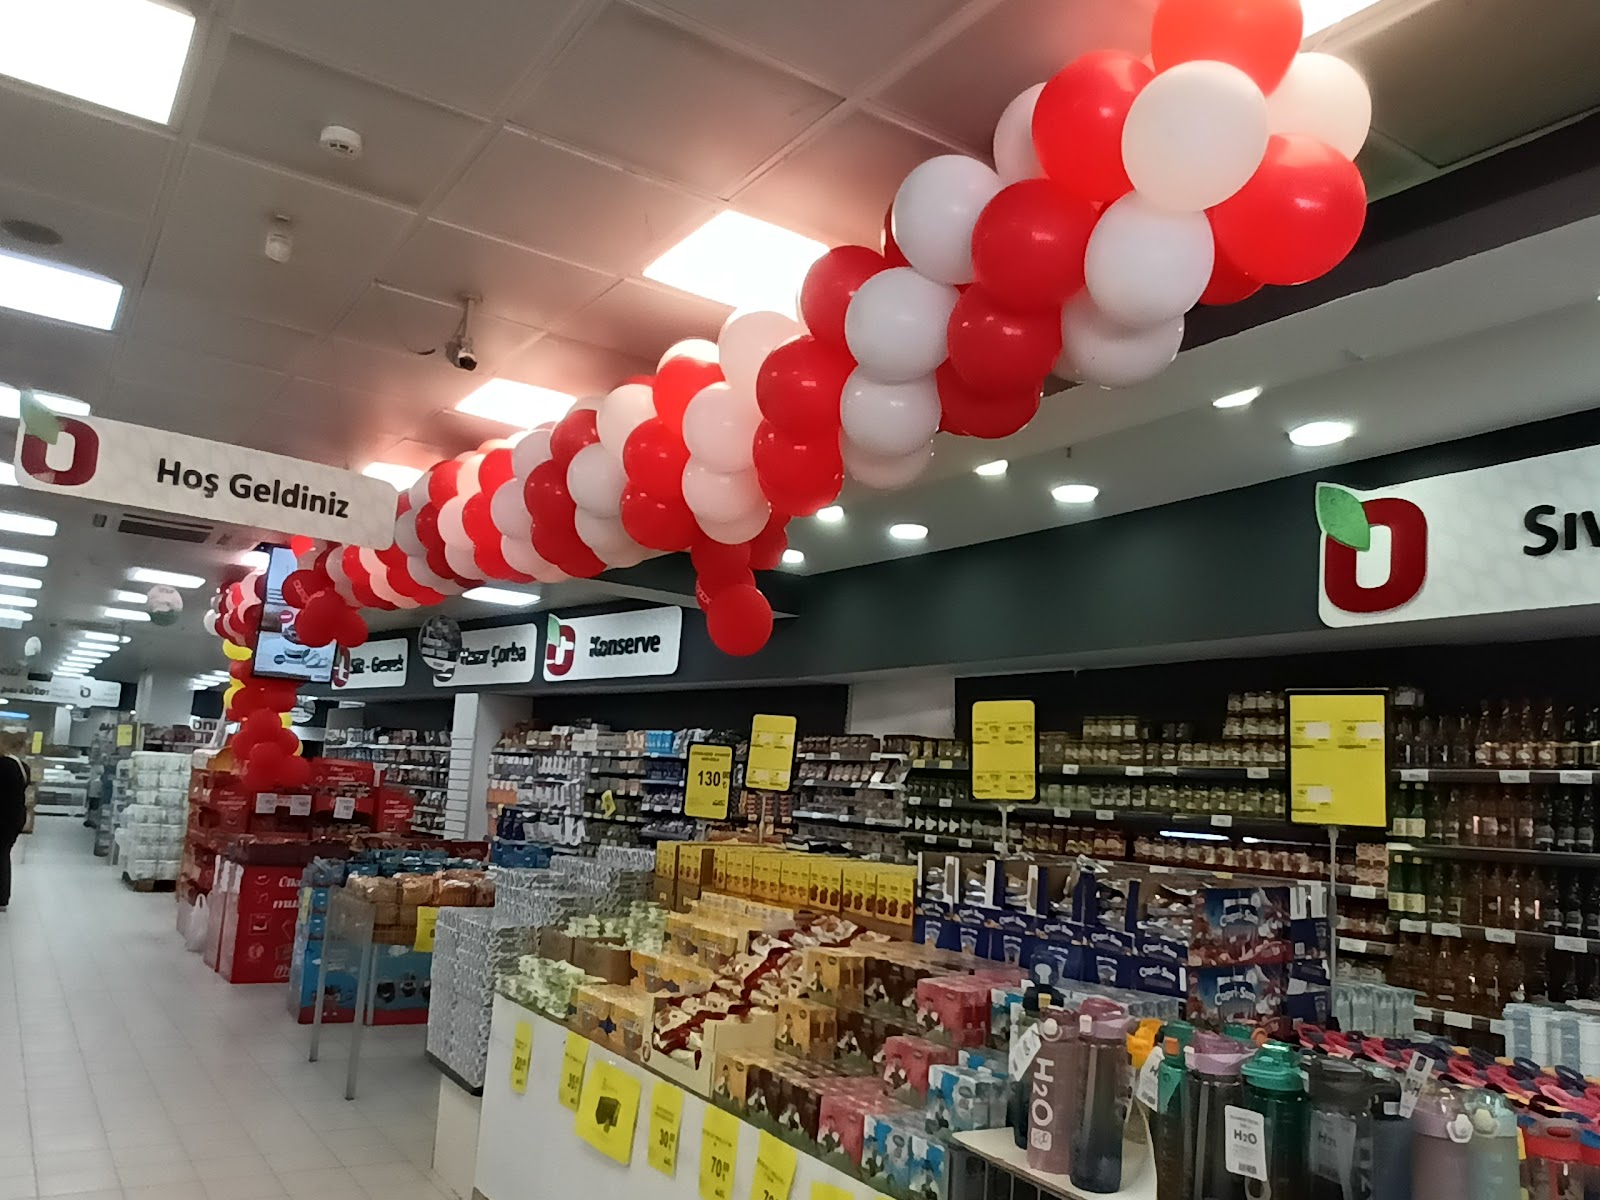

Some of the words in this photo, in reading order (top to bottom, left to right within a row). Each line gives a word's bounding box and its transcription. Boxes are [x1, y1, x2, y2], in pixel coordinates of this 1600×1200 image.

[157, 458, 219, 499] Hoş
[229, 473, 349, 519] Geldiniz
[698, 770, 721, 787] 130
[1233, 1128, 1258, 1145] H2O
